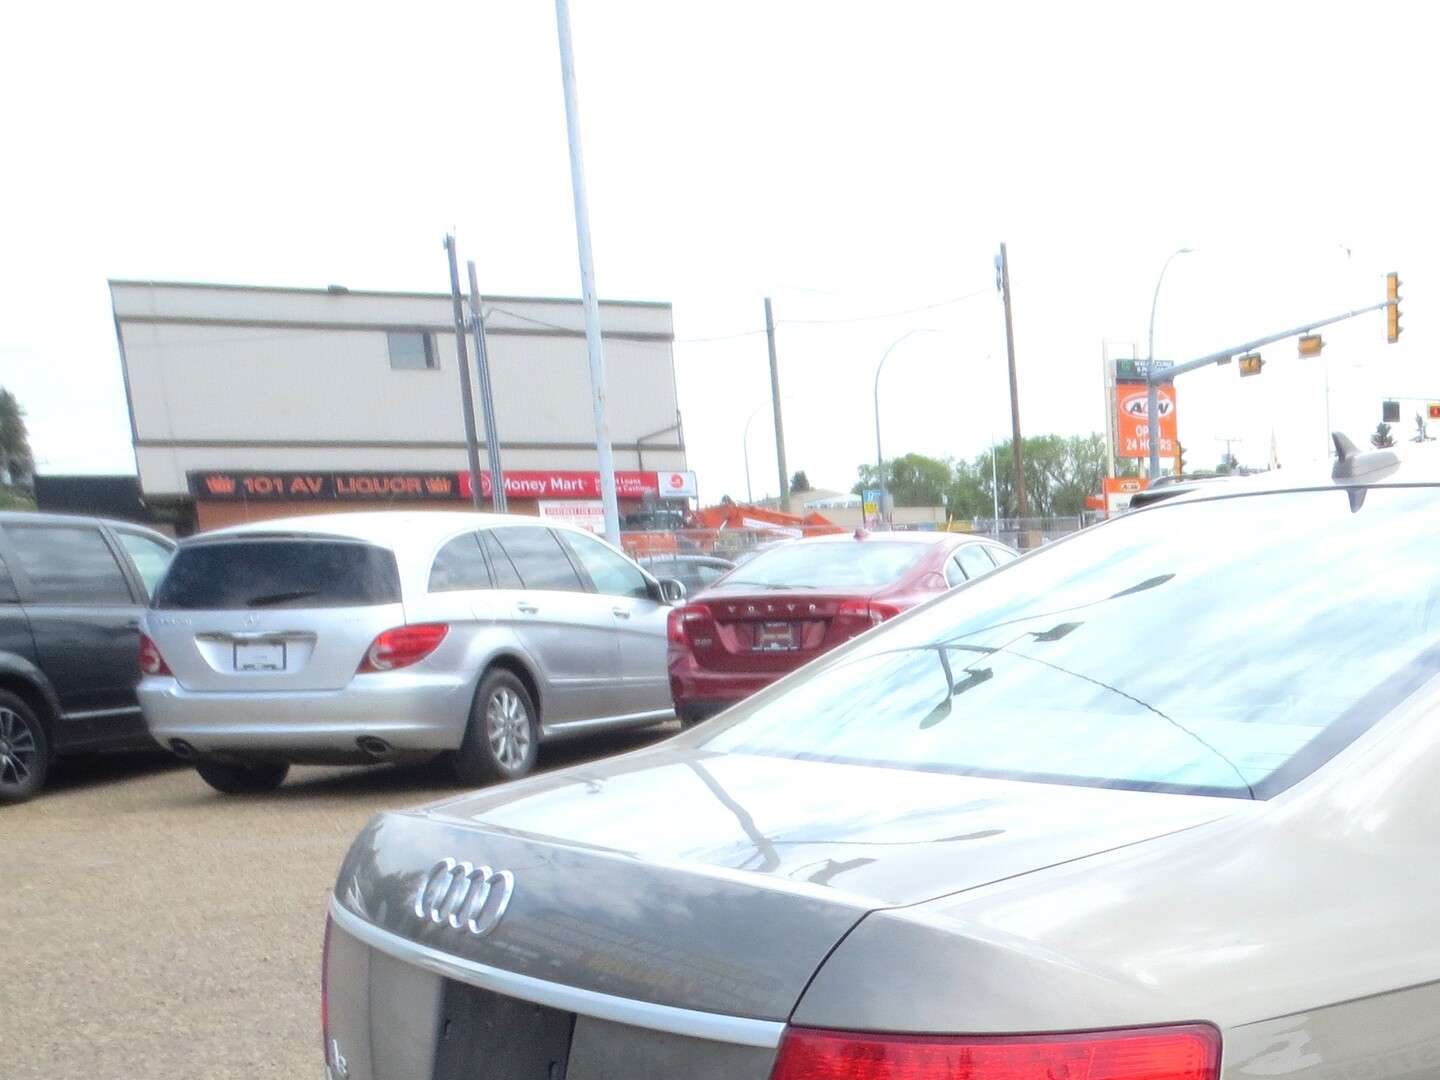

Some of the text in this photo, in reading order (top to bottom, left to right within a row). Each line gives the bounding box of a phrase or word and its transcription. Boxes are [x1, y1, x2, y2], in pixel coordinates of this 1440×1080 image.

[1130, 401, 1169, 415] AW
[1135, 424, 1162, 438] OP
[1139, 438, 1172, 451] HORS
[243, 476, 422, 494] 101 AV LIQUOR
[502, 477, 546, 493] Money
[550, 477, 584, 491] Mart
[727, 603, 817, 614] VOLVO
